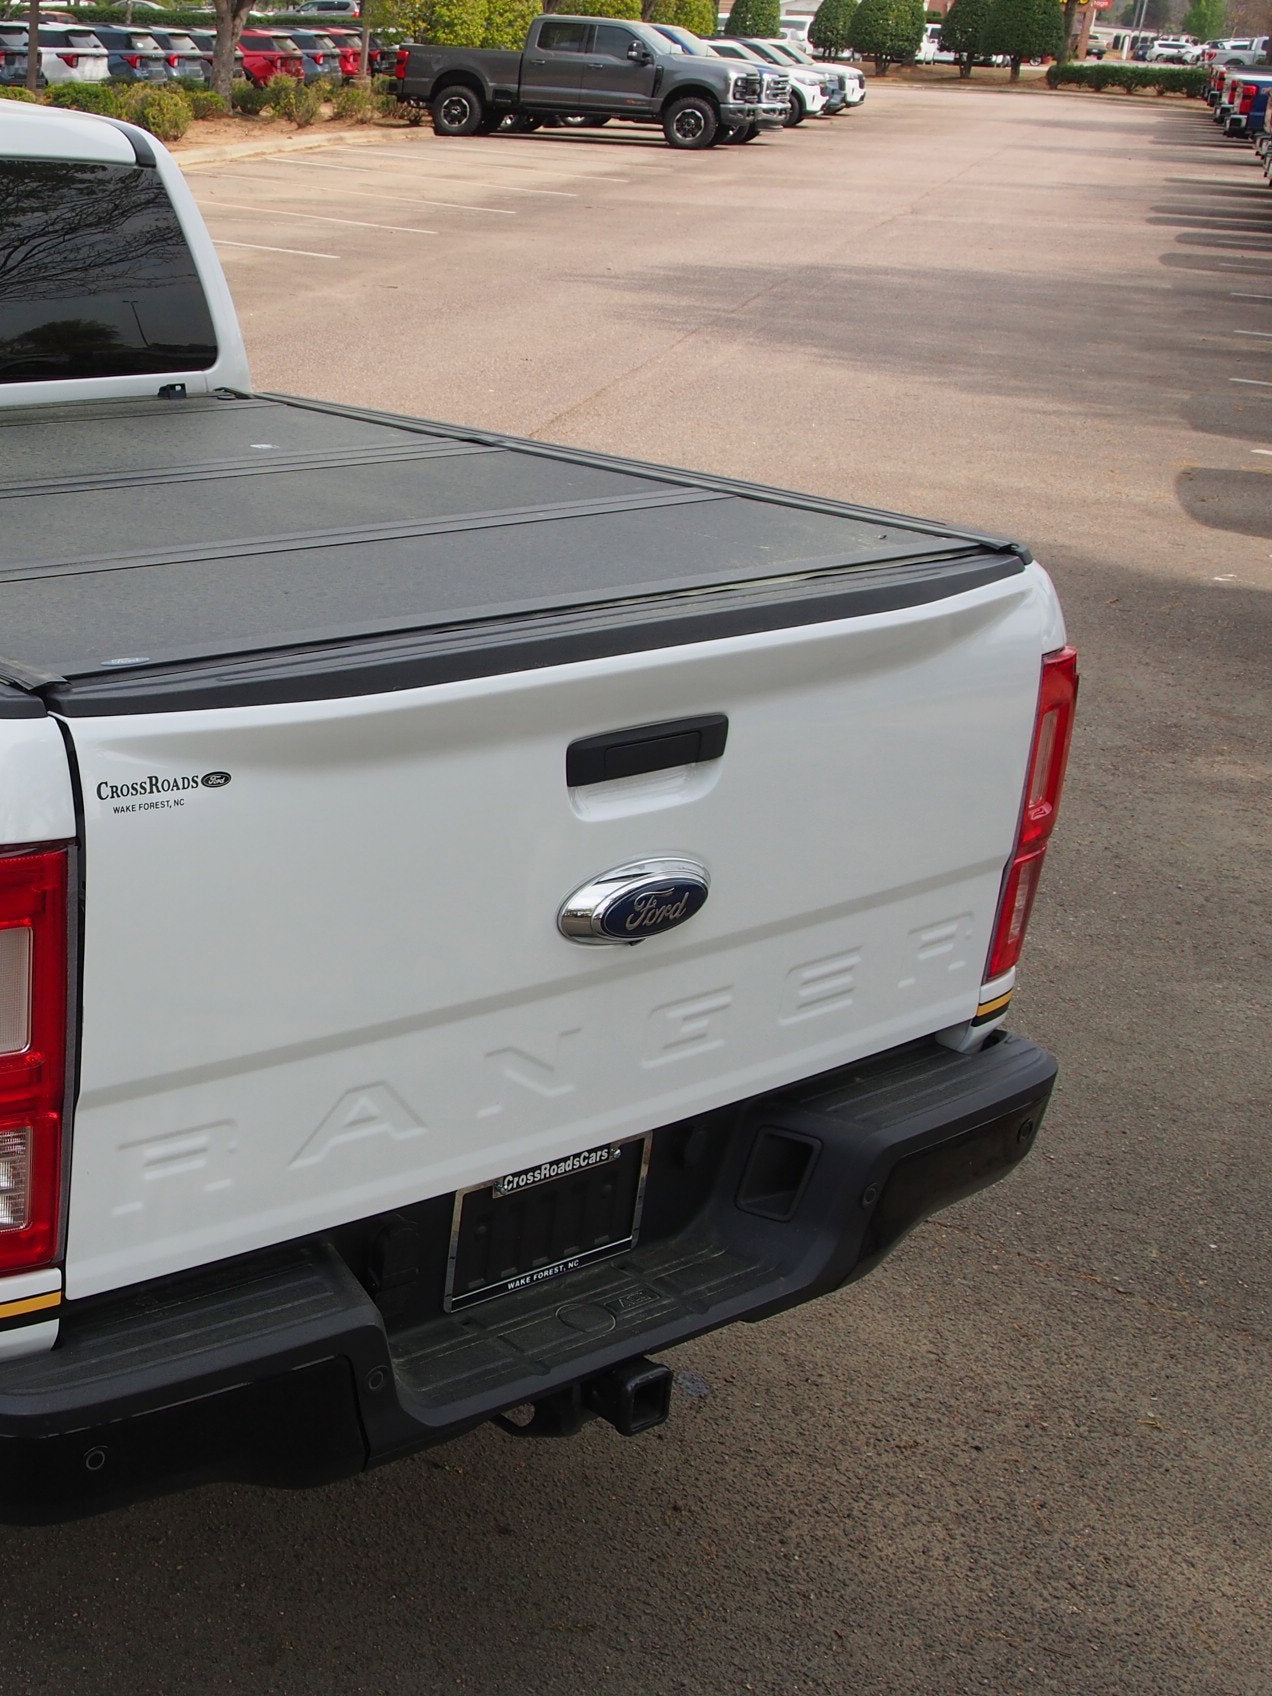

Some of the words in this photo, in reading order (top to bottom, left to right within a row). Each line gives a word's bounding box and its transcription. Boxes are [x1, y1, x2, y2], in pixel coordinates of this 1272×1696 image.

[113, 804, 136, 814] WAKE
[138, 800, 172, 811] FOREST,
[173, 798, 185, 806] NC
[625, 887, 690, 931] Ford
[112, 912, 974, 1216] RANGER
[503, 1147, 609, 1191] CrossRoadsCars
[508, 1276, 531, 1290] WAKE
[533, 1264, 566, 1281] FOREST,
[568, 1259, 579, 1269] NC
